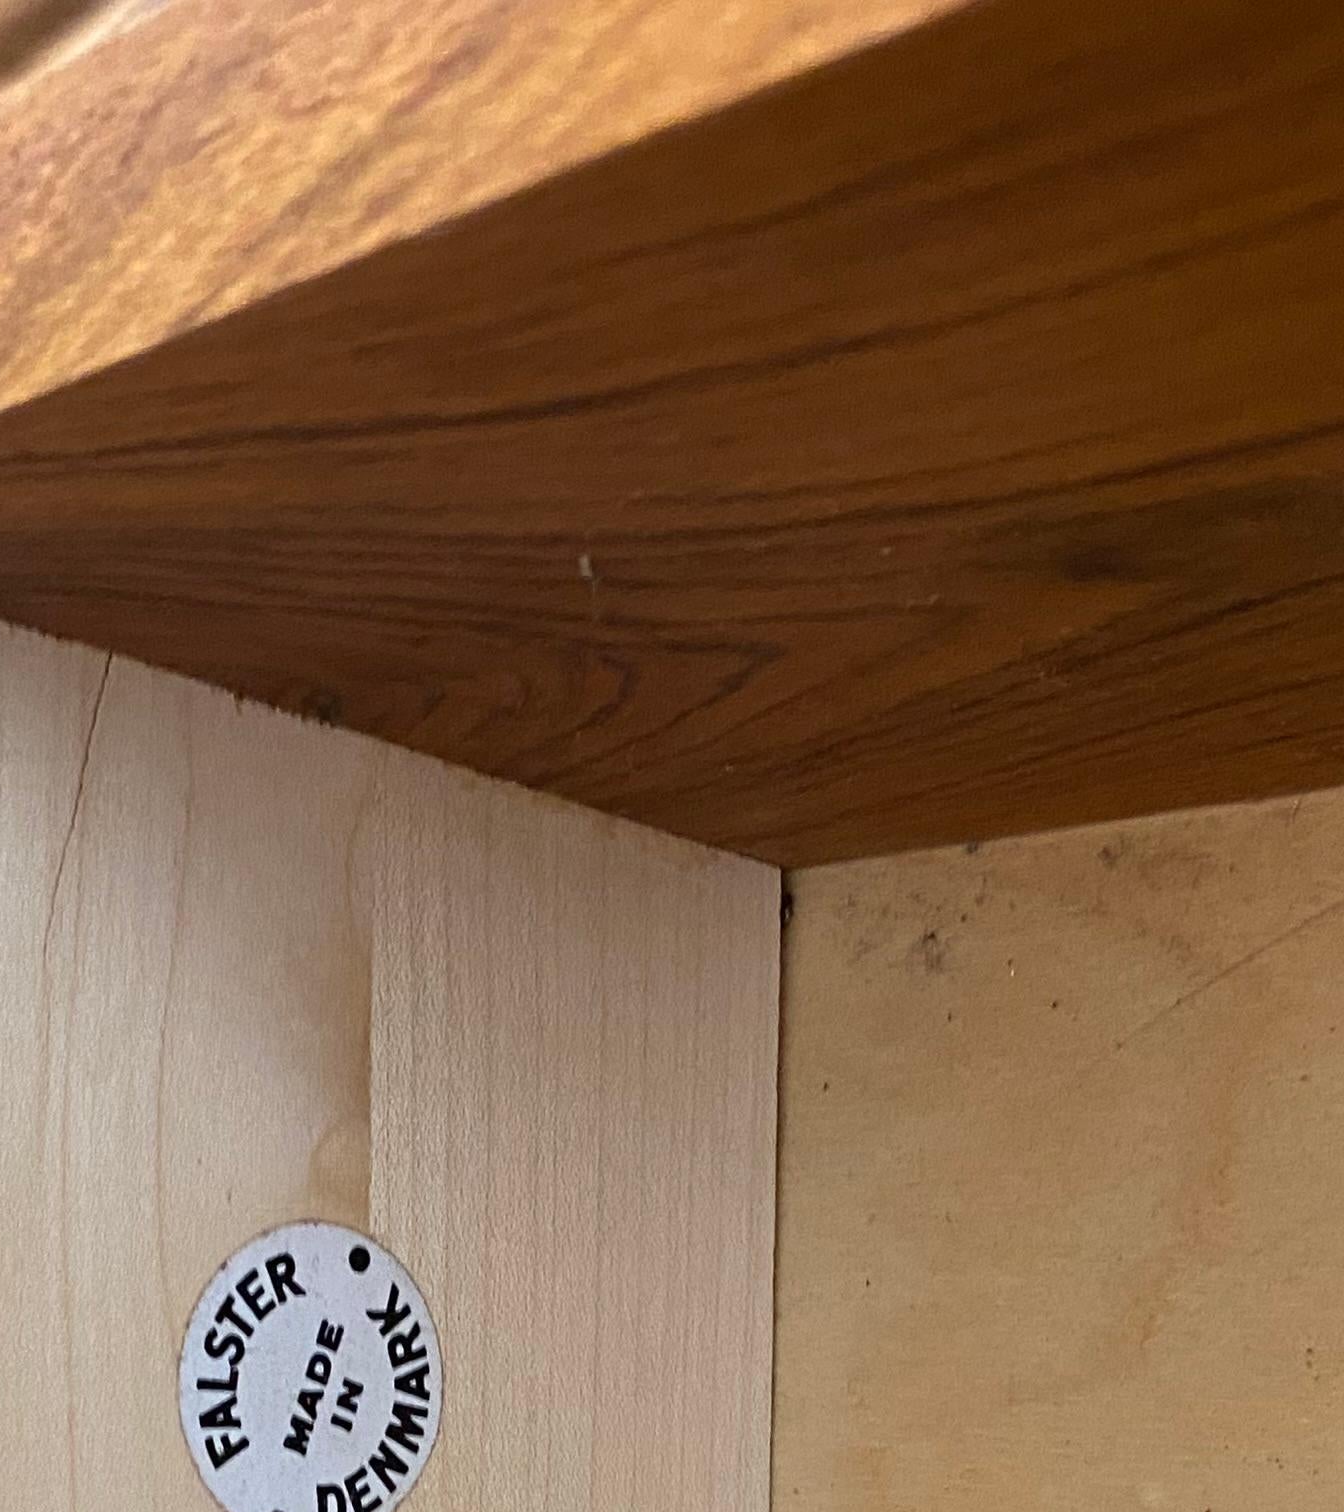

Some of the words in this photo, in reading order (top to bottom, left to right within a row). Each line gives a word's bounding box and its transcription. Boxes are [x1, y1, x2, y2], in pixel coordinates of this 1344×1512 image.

[196, 1253, 306, 1470] FALSTER
[283, 1319, 345, 1457] MADE
[330, 1377, 364, 1433] IN
